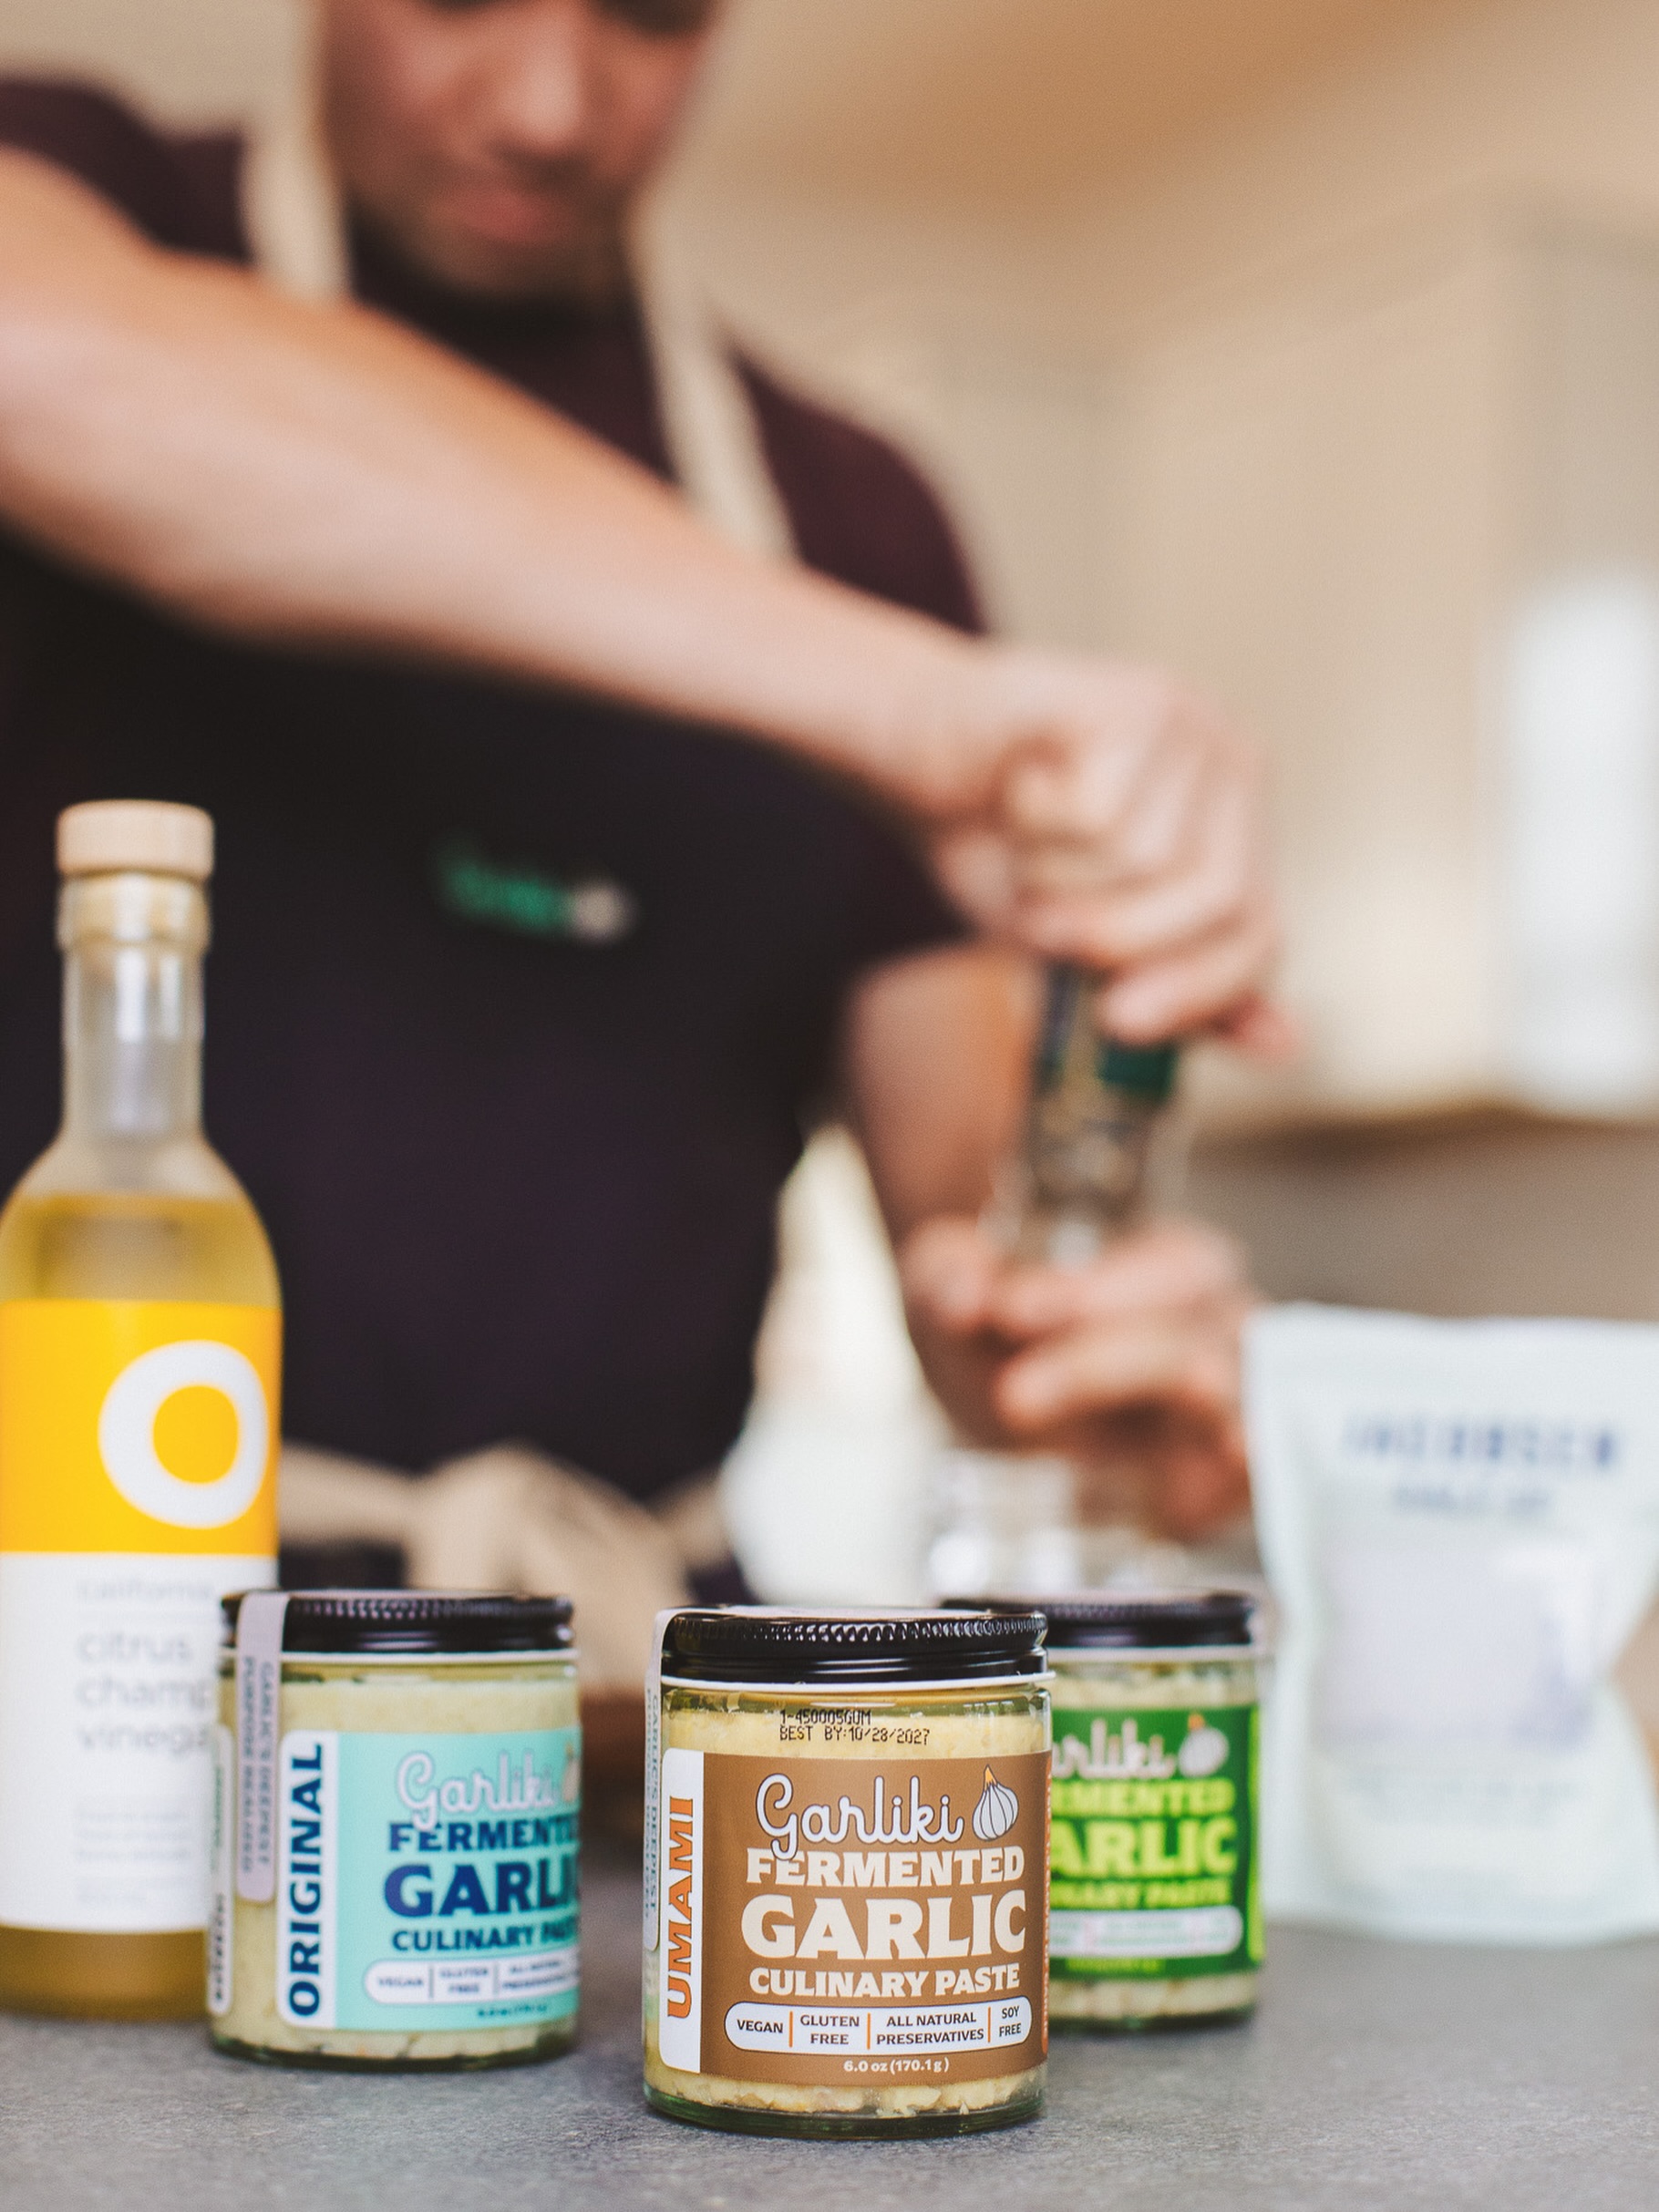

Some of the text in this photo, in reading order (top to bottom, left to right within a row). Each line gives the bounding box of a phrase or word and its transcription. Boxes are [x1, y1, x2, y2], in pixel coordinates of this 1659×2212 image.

[779, 1725, 813, 1742] BEST
[756, 1773, 964, 1860] Garliki
[746, 1846, 1025, 1888] FERMENTED
[288, 1743, 323, 2017] ORIGINAL
[384, 1855, 577, 1918] GARLI
[667, 1795, 693, 2018] UMAMI
[741, 1889, 1026, 1960] GARLIC
[392, 1926, 533, 1951] CULINARY
[749, 1963, 1020, 1997] CULINARY PASTE
[799, 2014, 860, 2027] GLUTEN
[886, 2011, 976, 2027] ALL NATURAL
[1001, 2006, 1020, 2019] SOY
[737, 2019, 784, 2033] VEGAN
[998, 2022, 1022, 2037] FREE
[809, 2033, 850, 2045] FREE
[876, 2029, 984, 2046] PRESERVATIVES
[843, 2060, 868, 2073] 6.0
[871, 2062, 888, 2073] oz
